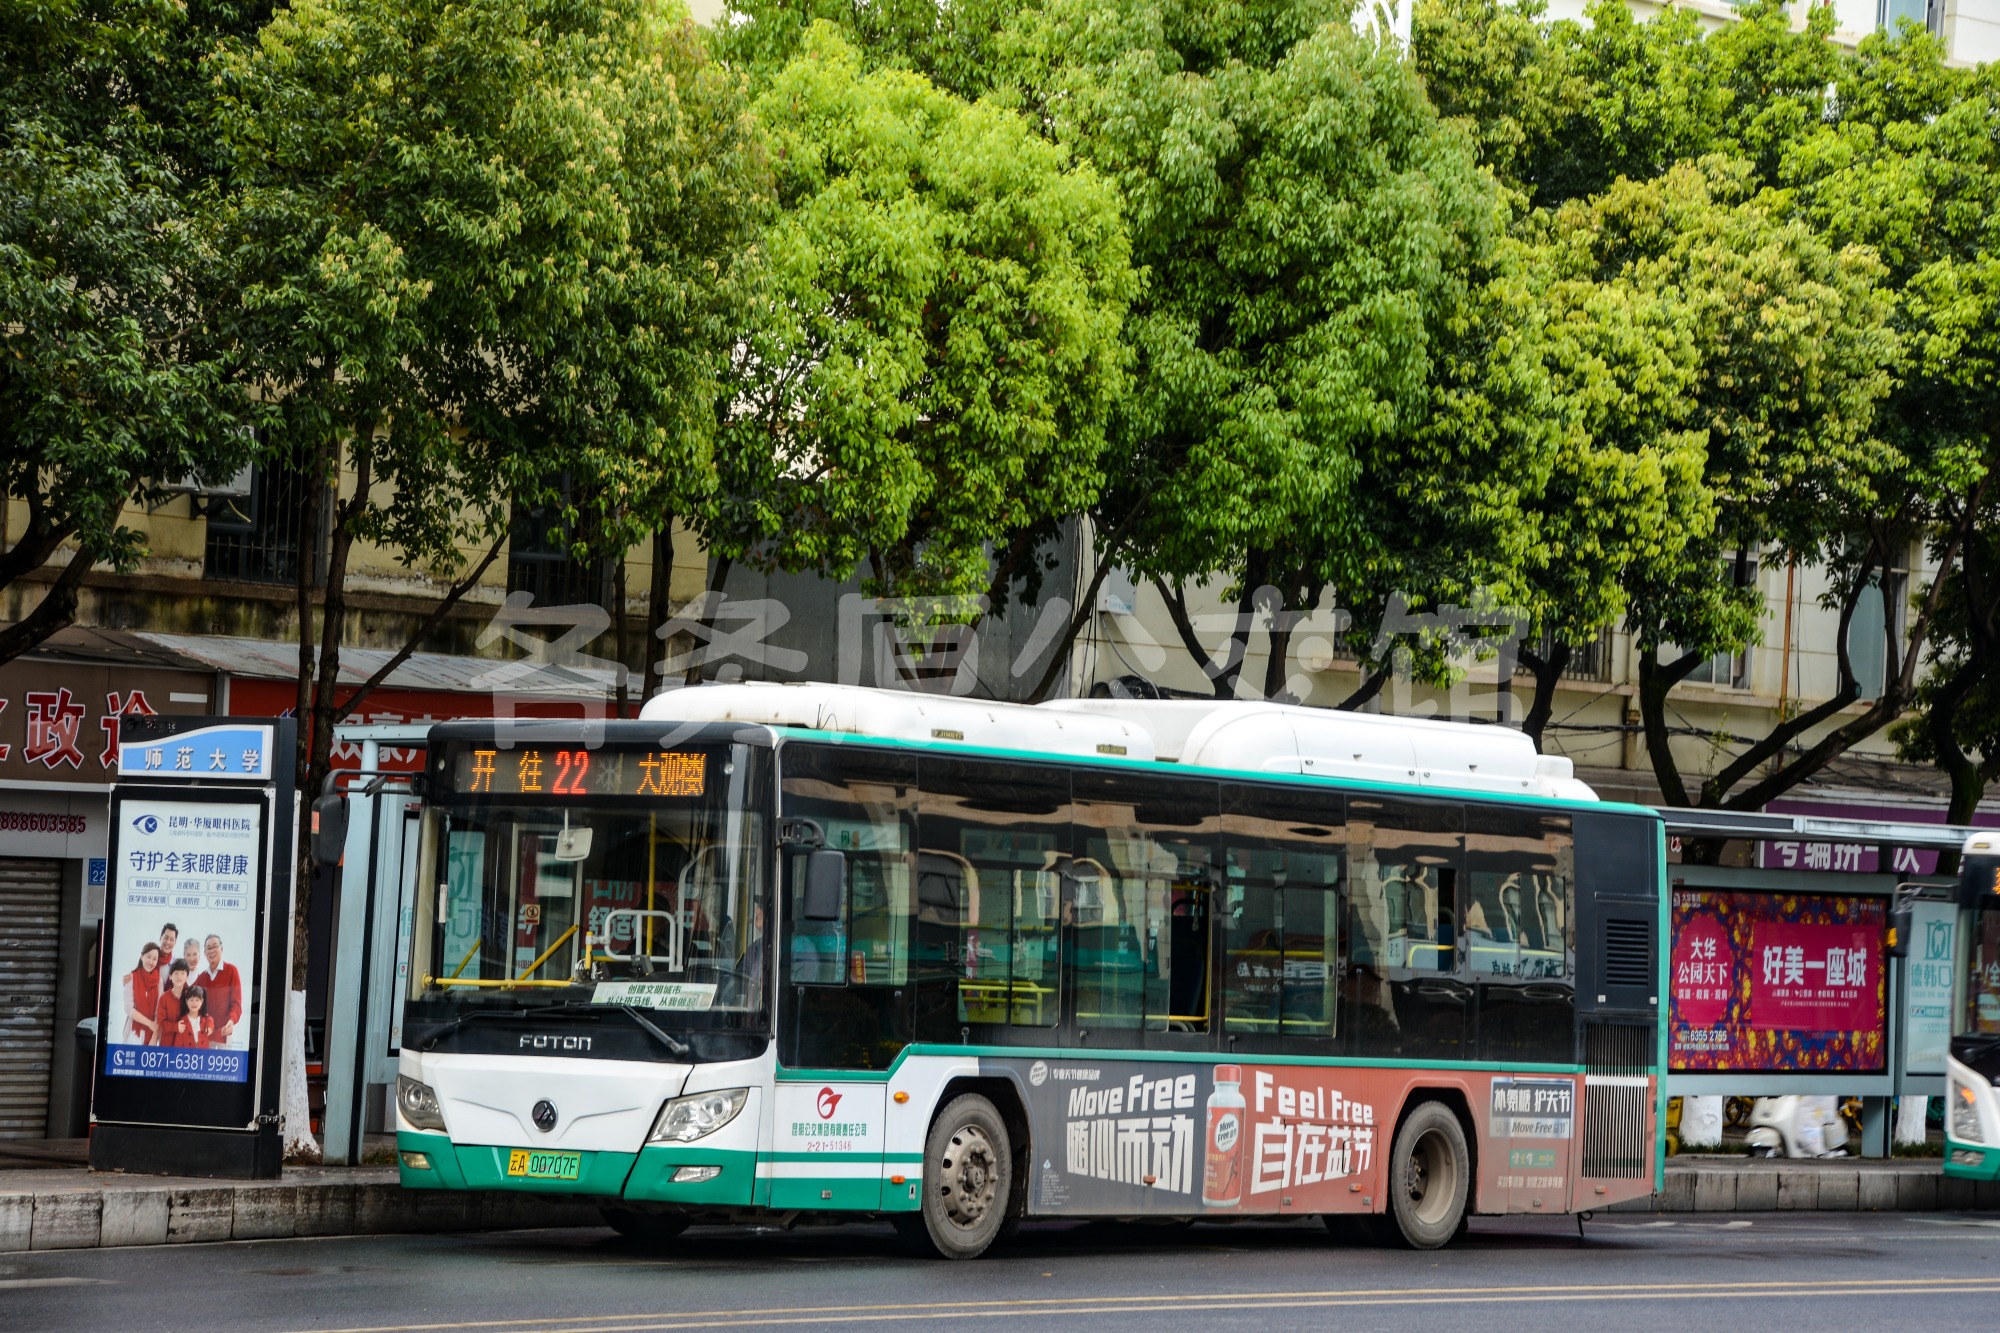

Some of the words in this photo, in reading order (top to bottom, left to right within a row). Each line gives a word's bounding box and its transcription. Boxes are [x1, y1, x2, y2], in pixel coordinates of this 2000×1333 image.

[145, 747, 260, 772] 师范大学
[552, 751, 589, 794] 22
[636, 752, 706, 795] 大观楼
[130, 850, 249, 876] 守护全家眼健康
[1691, 937, 1716, 960] 大华
[1678, 962, 1728, 985] 公园天下
[1763, 945, 1867, 987] 好美一座城
[628, 984, 682, 995] 创建文明城市
[519, 1035, 592, 1051] FOTON
[141, 1051, 204, 1070] 0871-6381
[207, 1056, 239, 1073] 9999
[1068, 1086, 1123, 1117] Move
[1127, 1074, 1195, 1112] Free
[1255, 1070, 1325, 1119] Feel
[1331, 1090, 1373, 1125] Free
[1534, 1088, 1570, 1113] 护关节
[792, 1123, 867, 1137] 昆明公交集团有限责任公司
[1217, 1131, 1230, 1143] Free
[1220, 1120, 1235, 1131] Move
[1512, 1121, 1534, 1133] Move
[1535, 1121, 1552, 1133] Free
[1067, 1114, 1194, 1194] 随心而动
[1251, 1116, 1373, 1194] 自在益节
